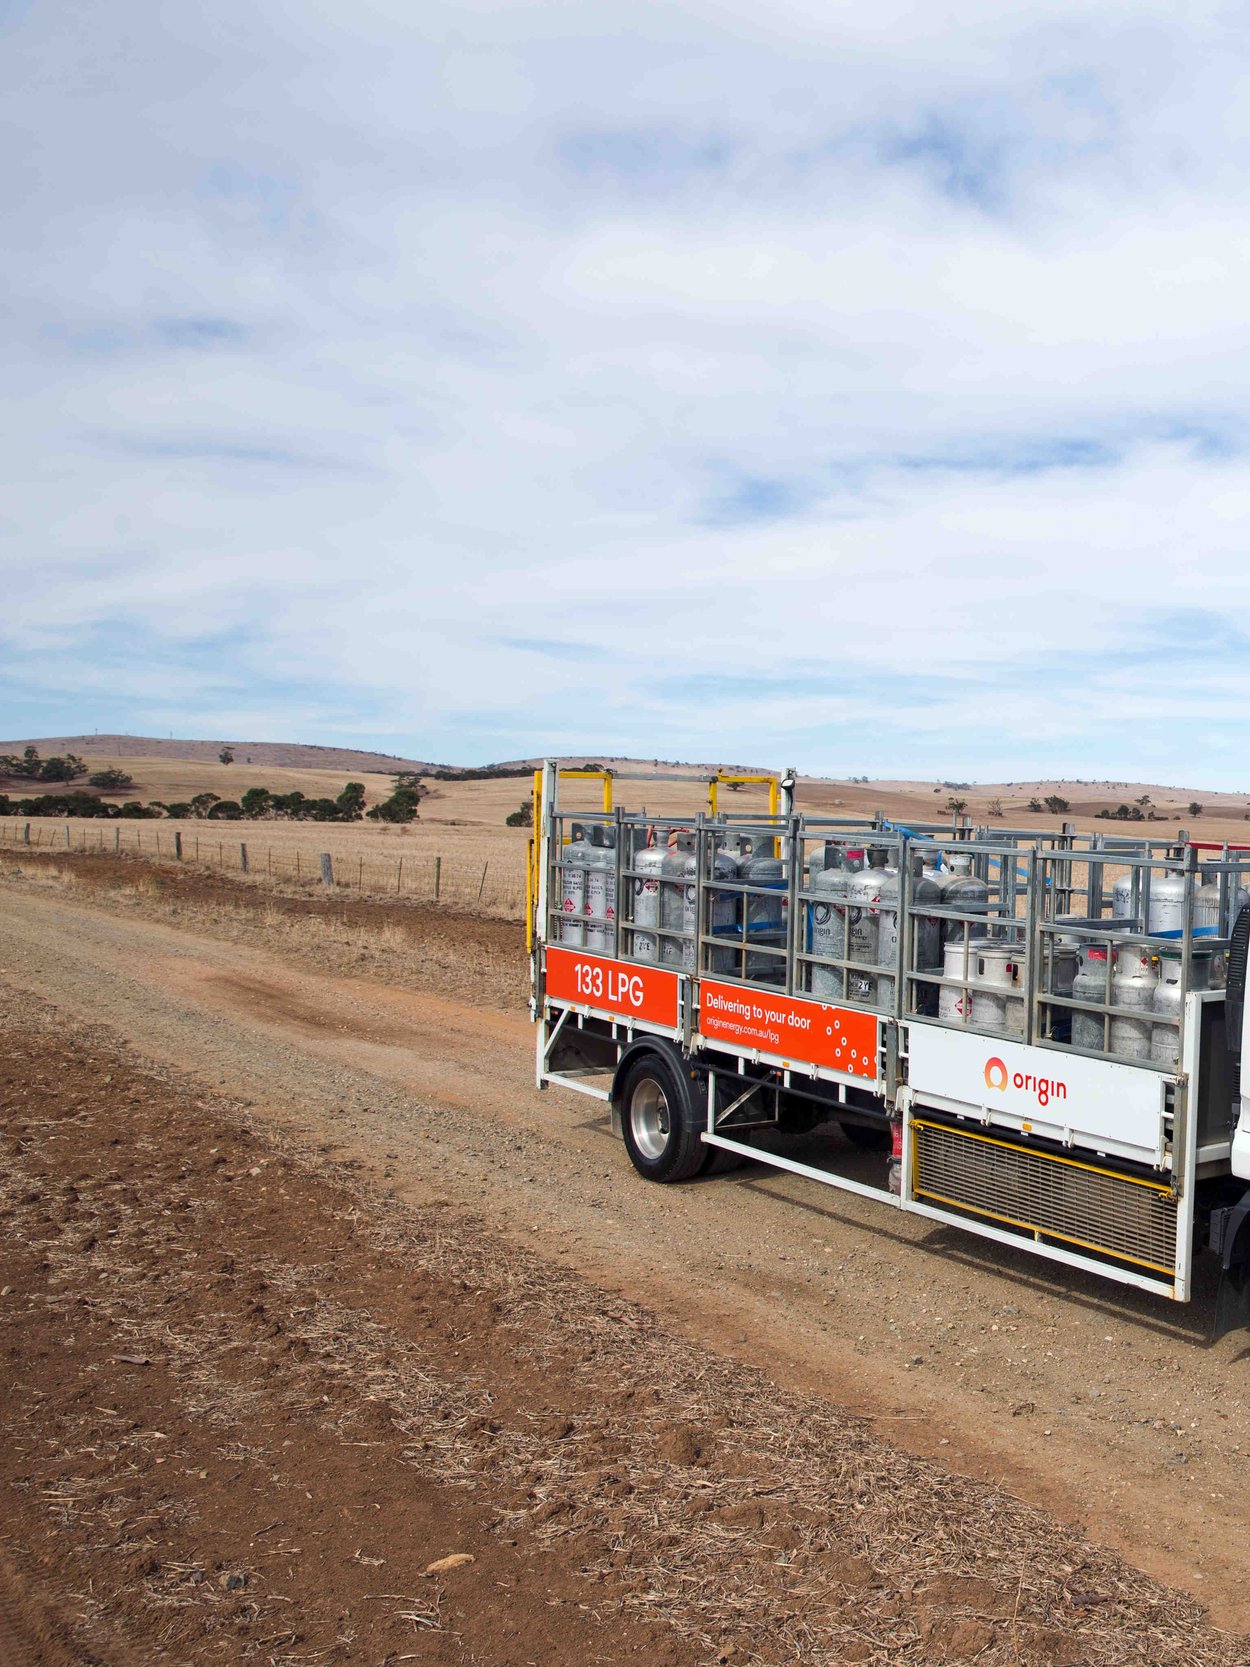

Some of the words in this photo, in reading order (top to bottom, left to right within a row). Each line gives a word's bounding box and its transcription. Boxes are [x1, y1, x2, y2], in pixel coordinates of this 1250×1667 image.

[575, 963, 603, 997] 133
[608, 970, 644, 1007] LPG
[706, 992, 751, 1020] Delivering
[752, 1004, 763, 1019] to
[764, 1009, 786, 1024] your
[787, 1011, 811, 1030] door
[706, 1016, 780, 1044] originenergy.com.au/lpg
[1013, 1072, 1067, 1106] origin
